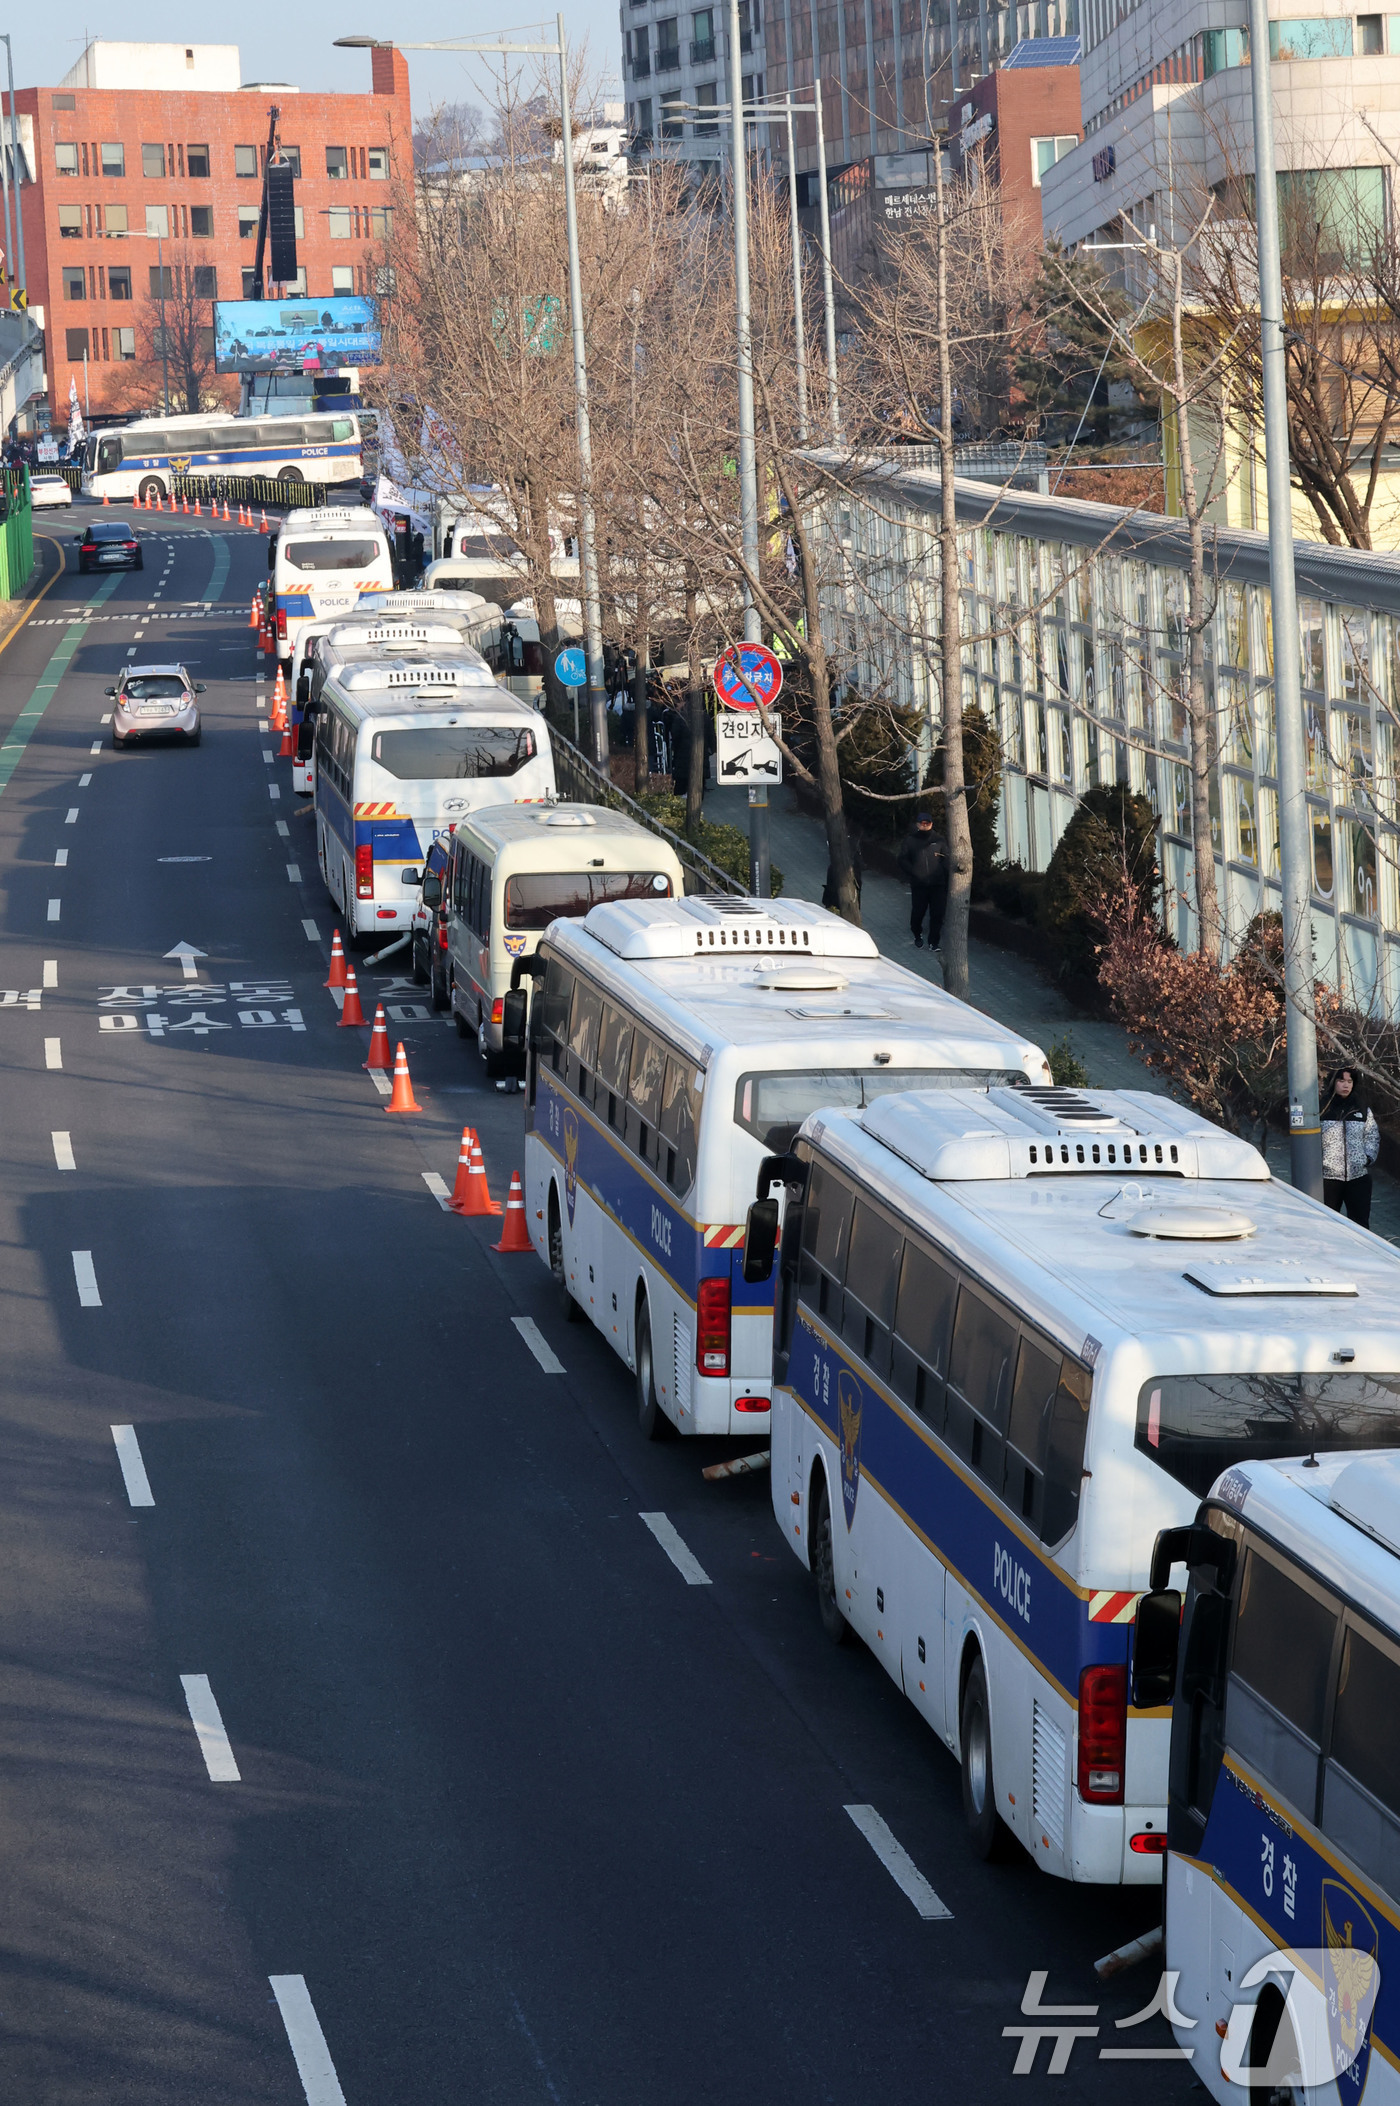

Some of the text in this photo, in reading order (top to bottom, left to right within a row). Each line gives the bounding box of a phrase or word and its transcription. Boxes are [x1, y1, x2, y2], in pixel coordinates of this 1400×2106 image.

[301, 447, 329, 456] POLICE
[319, 598, 350, 606] POLICE
[97, 980, 295, 1008] 장충동
[98, 1008, 307, 1036] 약수역
[651, 1203, 672, 1257] POLICE
[813, 1352, 830, 1406] 경찰
[843, 1479, 856, 1505] POLICE
[993, 1540, 1031, 1624] POLICE
[1260, 1833, 1298, 1921] 경찰
[1335, 2042, 1361, 2087] POLICE
